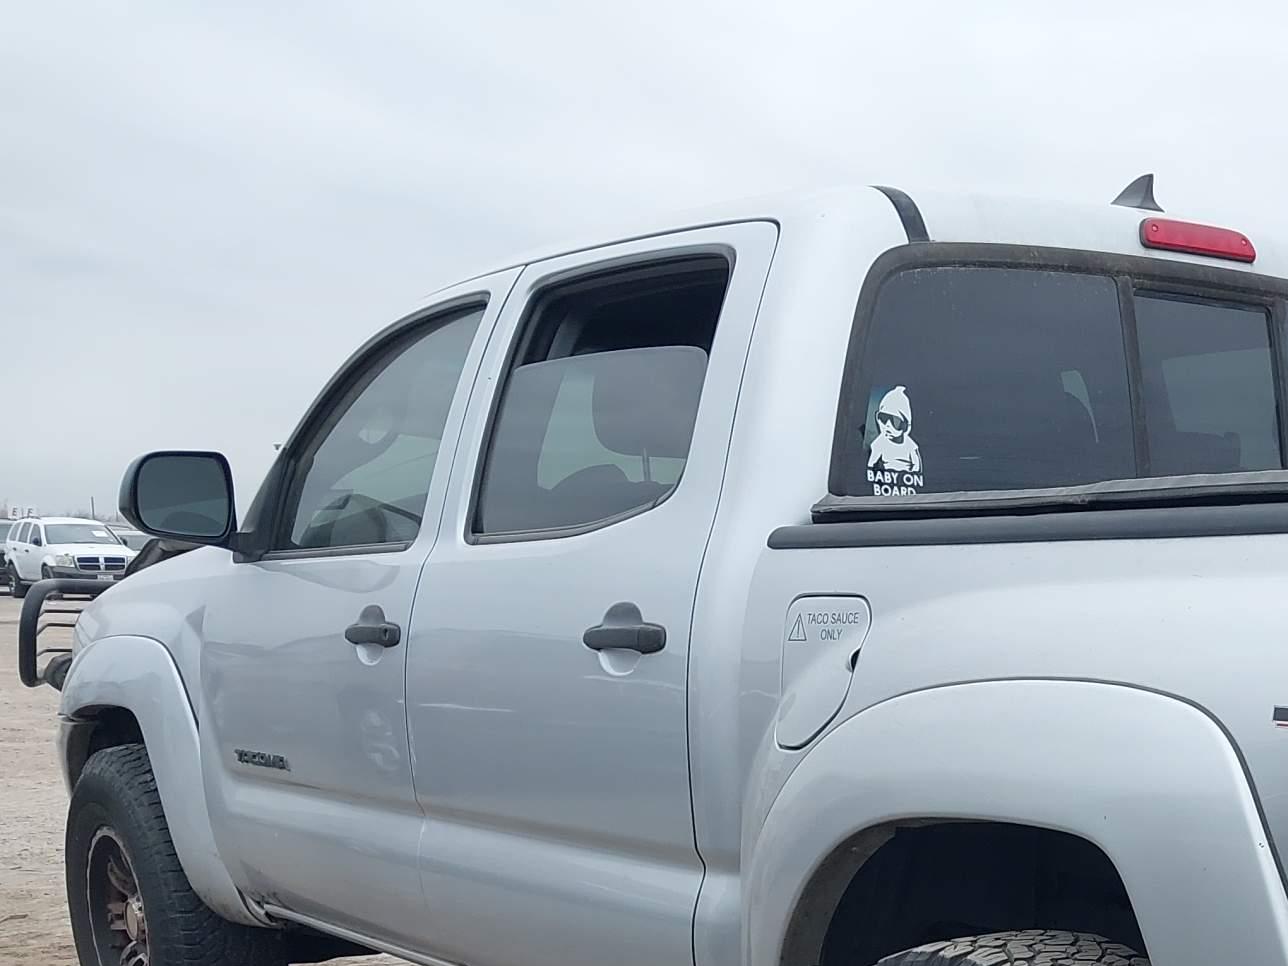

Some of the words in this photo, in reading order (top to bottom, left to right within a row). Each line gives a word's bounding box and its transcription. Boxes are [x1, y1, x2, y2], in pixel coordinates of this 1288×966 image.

[867, 470, 898, 483] BABY
[903, 474, 924, 486] ON
[873, 484, 916, 496] BOARD
[807, 613, 829, 625] TACO
[830, 612, 859, 625] SAUCE
[820, 628, 842, 641] ONLY
